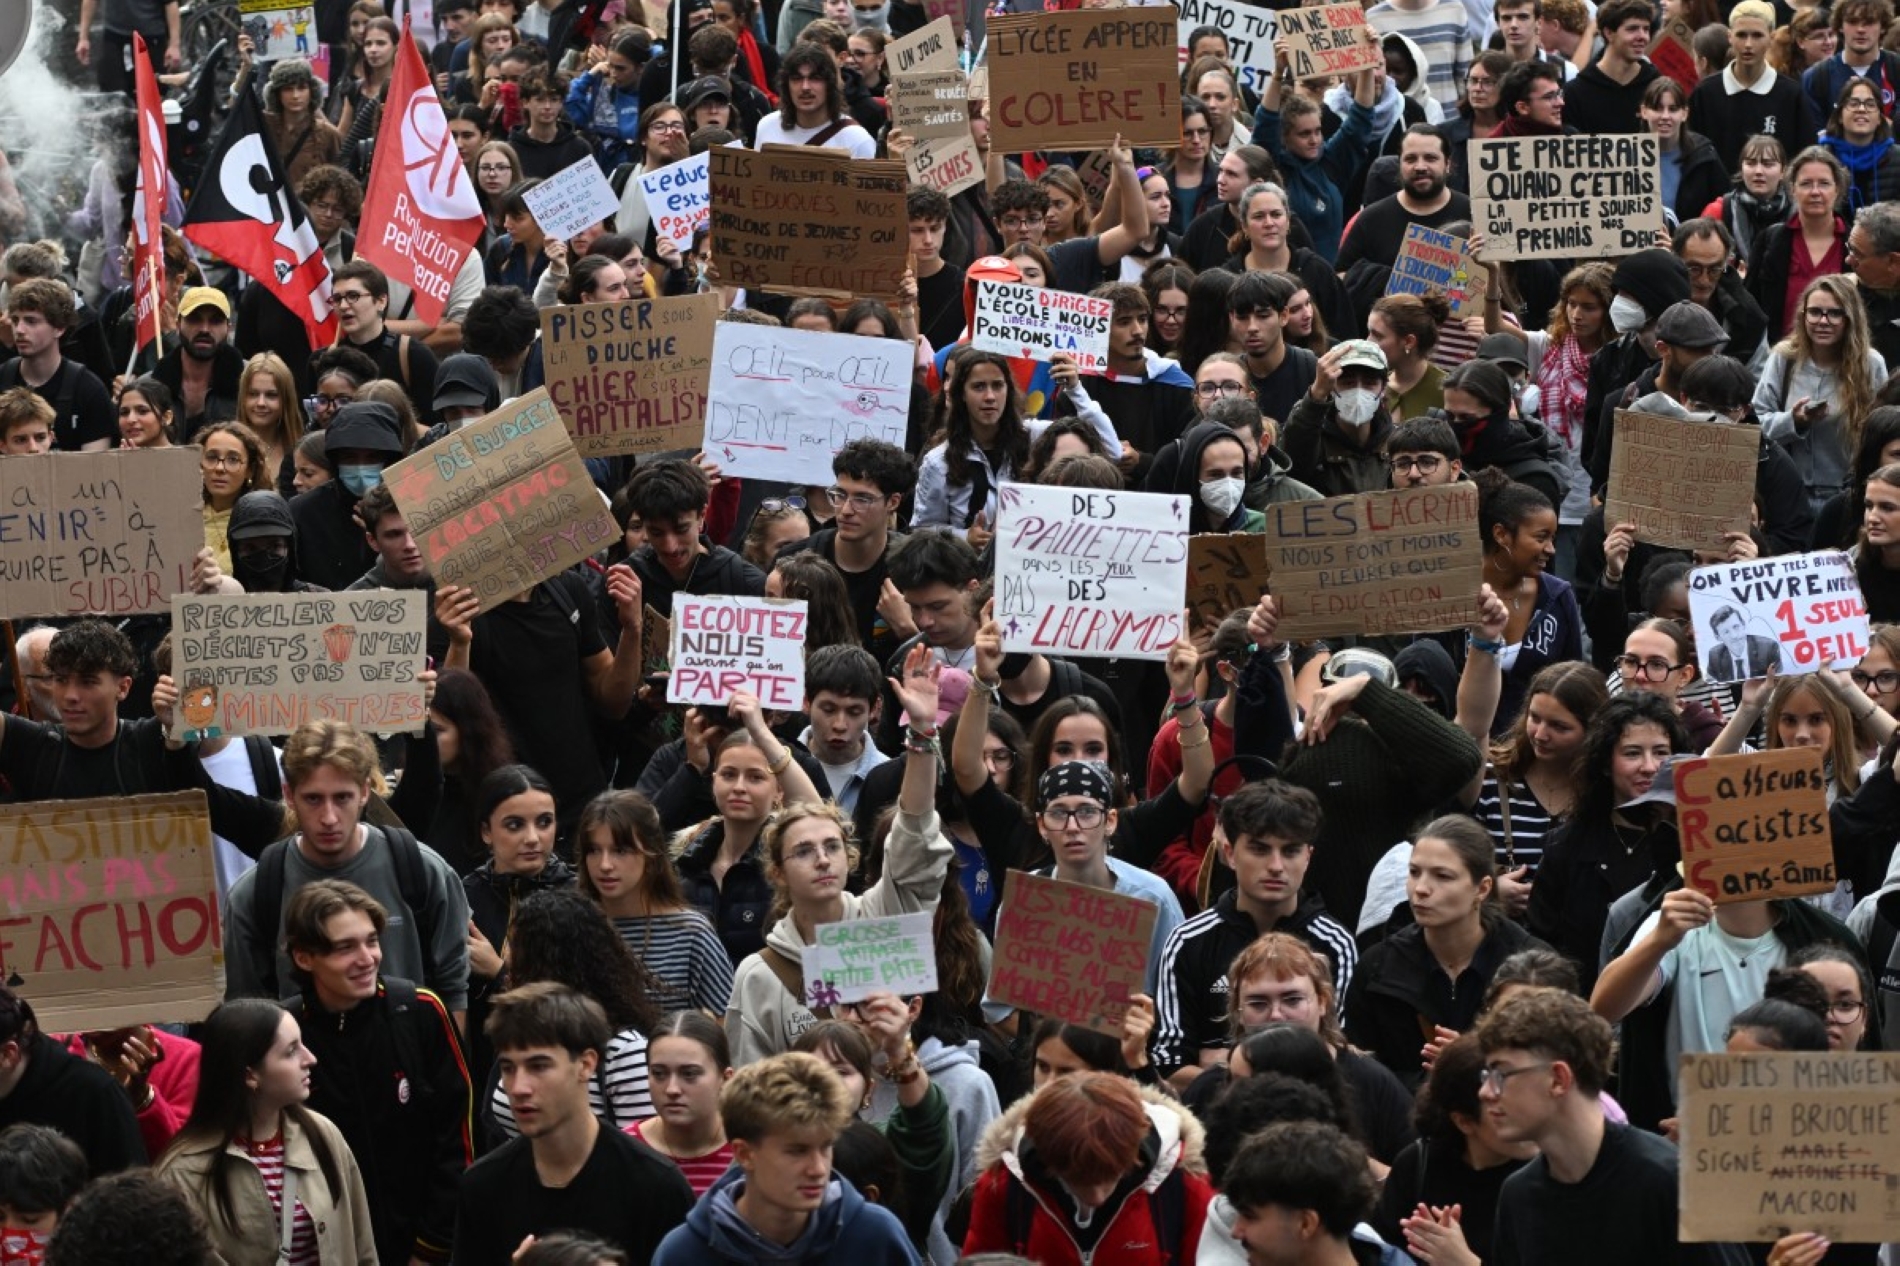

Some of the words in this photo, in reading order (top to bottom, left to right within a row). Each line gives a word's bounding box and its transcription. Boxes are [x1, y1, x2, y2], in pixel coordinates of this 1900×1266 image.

[997, 24, 1071, 56] LYCÉE
[1083, 21, 1174, 49] APPERT
[1281, 13, 1305, 35] ON
[1304, 10, 1327, 31] NE
[897, 47, 915, 71] UN
[919, 33, 943, 61] JOUR
[1306, 31, 1331, 52] PAS
[1068, 61, 1097, 82] EN
[1296, 49, 1315, 76] LA
[1000, 85, 1144, 127] COLÈRE
[1158, 82, 1167, 117] !
[711, 154, 752, 178] ILS
[770, 165, 824, 182] PARLENT
[914, 149, 933, 173] LES
[1481, 141, 1522, 171] JE
[667, 192, 699, 211] est
[712, 184, 746, 208] MAL
[856, 200, 896, 218] NOUS
[1486, 170, 1562, 201] QUAND
[1488, 204, 1505, 219] LA
[1528, 198, 1590, 222] PETITE
[1598, 197, 1653, 218] SOURIS
[713, 210, 771, 237] PARLONS
[779, 223, 798, 237] DE
[805, 222, 861, 241] JEUNES
[871, 228, 896, 243] QUI
[1488, 218, 1512, 236] QUI
[1516, 221, 1593, 253] PRENAIS
[1601, 219, 1624, 230] NOS
[715, 238, 737, 256] NE
[744, 242, 790, 262] SONT
[730, 260, 770, 284] PAS
[978, 297, 1050, 320] L'ÉCOLE
[1059, 312, 1108, 333] NOUS
[982, 282, 1034, 301] VOUS
[1038, 291, 1111, 316] DIRIGEZ
[552, 302, 653, 343] PISSER
[662, 306, 693, 324] SOUS
[977, 316, 1052, 348] PORTONS
[551, 353, 568, 365] LA
[586, 337, 676, 365] DOUCHE
[551, 366, 637, 406] CHIER
[651, 378, 677, 394] SUR
[683, 376, 698, 390] LE
[803, 366, 835, 384] pour
[434, 441, 473, 482] DE
[472, 398, 556, 456] BUDGET
[709, 400, 797, 443] DENT
[800, 434, 828, 448] pour
[1622, 414, 1730, 454] MACRON
[12, 486, 36, 507] a
[72, 479, 122, 500] un
[407, 476, 486, 531] DANS
[485, 442, 544, 490] LES
[1672, 483, 1715, 507] LES
[129, 501, 156, 530] à
[1072, 494, 1116, 519] DES
[1277, 502, 1358, 538] LES
[1366, 490, 1477, 531] LACRYMO
[441, 536, 500, 582] QUE
[501, 493, 581, 548] POUR
[1011, 516, 1190, 564] PAILLETTES
[1281, 547, 1334, 566] NOUS
[1347, 540, 1393, 562] FONT
[1402, 532, 1463, 551] MOINS
[78, 542, 131, 578] PAS
[1022, 558, 1061, 572] DANS
[1070, 560, 1093, 575] LES
[1319, 563, 1400, 589] PLEURER
[1408, 557, 1448, 574] QUE
[1693, 571, 1722, 590] ON
[1730, 563, 1776, 582] PEUT
[1731, 574, 1823, 604] VIVRE
[1827, 576, 1855, 593] AVEC
[1003, 574, 1036, 614] PAS
[1069, 579, 1107, 601] DES
[182, 599, 336, 632] RECYCLER
[349, 599, 406, 623] VOS
[682, 604, 806, 640] ECOUTEZ
[1031, 604, 1181, 652] LACRYMOS
[1775, 599, 1807, 642] 1
[1805, 598, 1866, 625] SEUL
[182, 629, 309, 662] DÉCHETS
[359, 631, 422, 656] N'EN
[681, 632, 764, 657] NOUS
[1794, 632, 1867, 664] OEIL
[183, 664, 278, 687] FAITES
[292, 663, 344, 684] PAS
[360, 660, 415, 682] DES
[685, 656, 738, 668] avant
[675, 668, 796, 704] PARTE
[223, 692, 425, 732] MINISTRES
[104, 852, 178, 898] PAS
[1012, 873, 1054, 913] ILS
[1059, 887, 1158, 936] JOUENT
[820, 921, 900, 947] GROSSE
[997, 908, 1056, 945] AVEC
[1057, 925, 1095, 955] NOS
[1100, 935, 1146, 971] VIES
[822, 963, 874, 987] PETITE
[1005, 941, 1071, 977] COMME
[1079, 960, 1109, 988] AU
[1708, 1104, 1734, 1137] DE
[1750, 1103, 1773, 1135] LA
[1696, 1144, 1764, 1173] SIGNÉ
[1770, 1163, 1881, 1181] ANTOINETTE
[1759, 1191, 1857, 1215] MACRON
